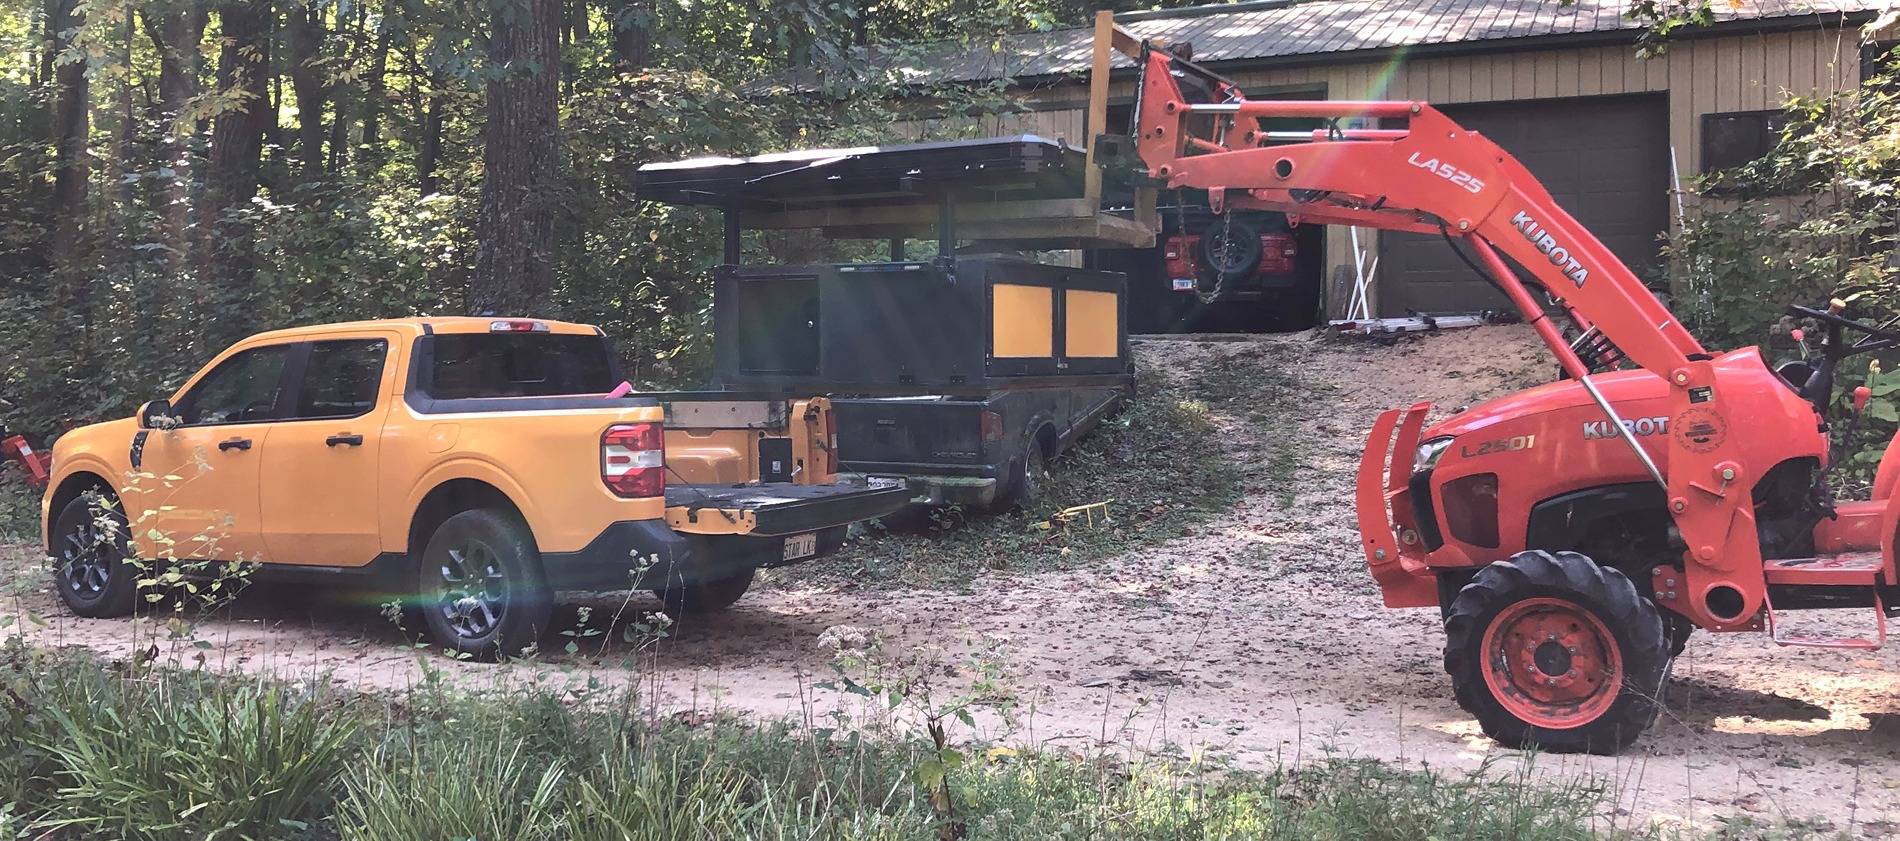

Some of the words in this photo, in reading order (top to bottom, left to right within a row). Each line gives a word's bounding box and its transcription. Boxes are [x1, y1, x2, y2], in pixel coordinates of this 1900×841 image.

[1407, 152, 1485, 194] LA525
[1511, 210, 1590, 289] KUBOTA
[1583, 416, 1670, 440] KUBOT
[1461, 434, 1535, 459] L2501
[784, 541, 801, 559] STAR
